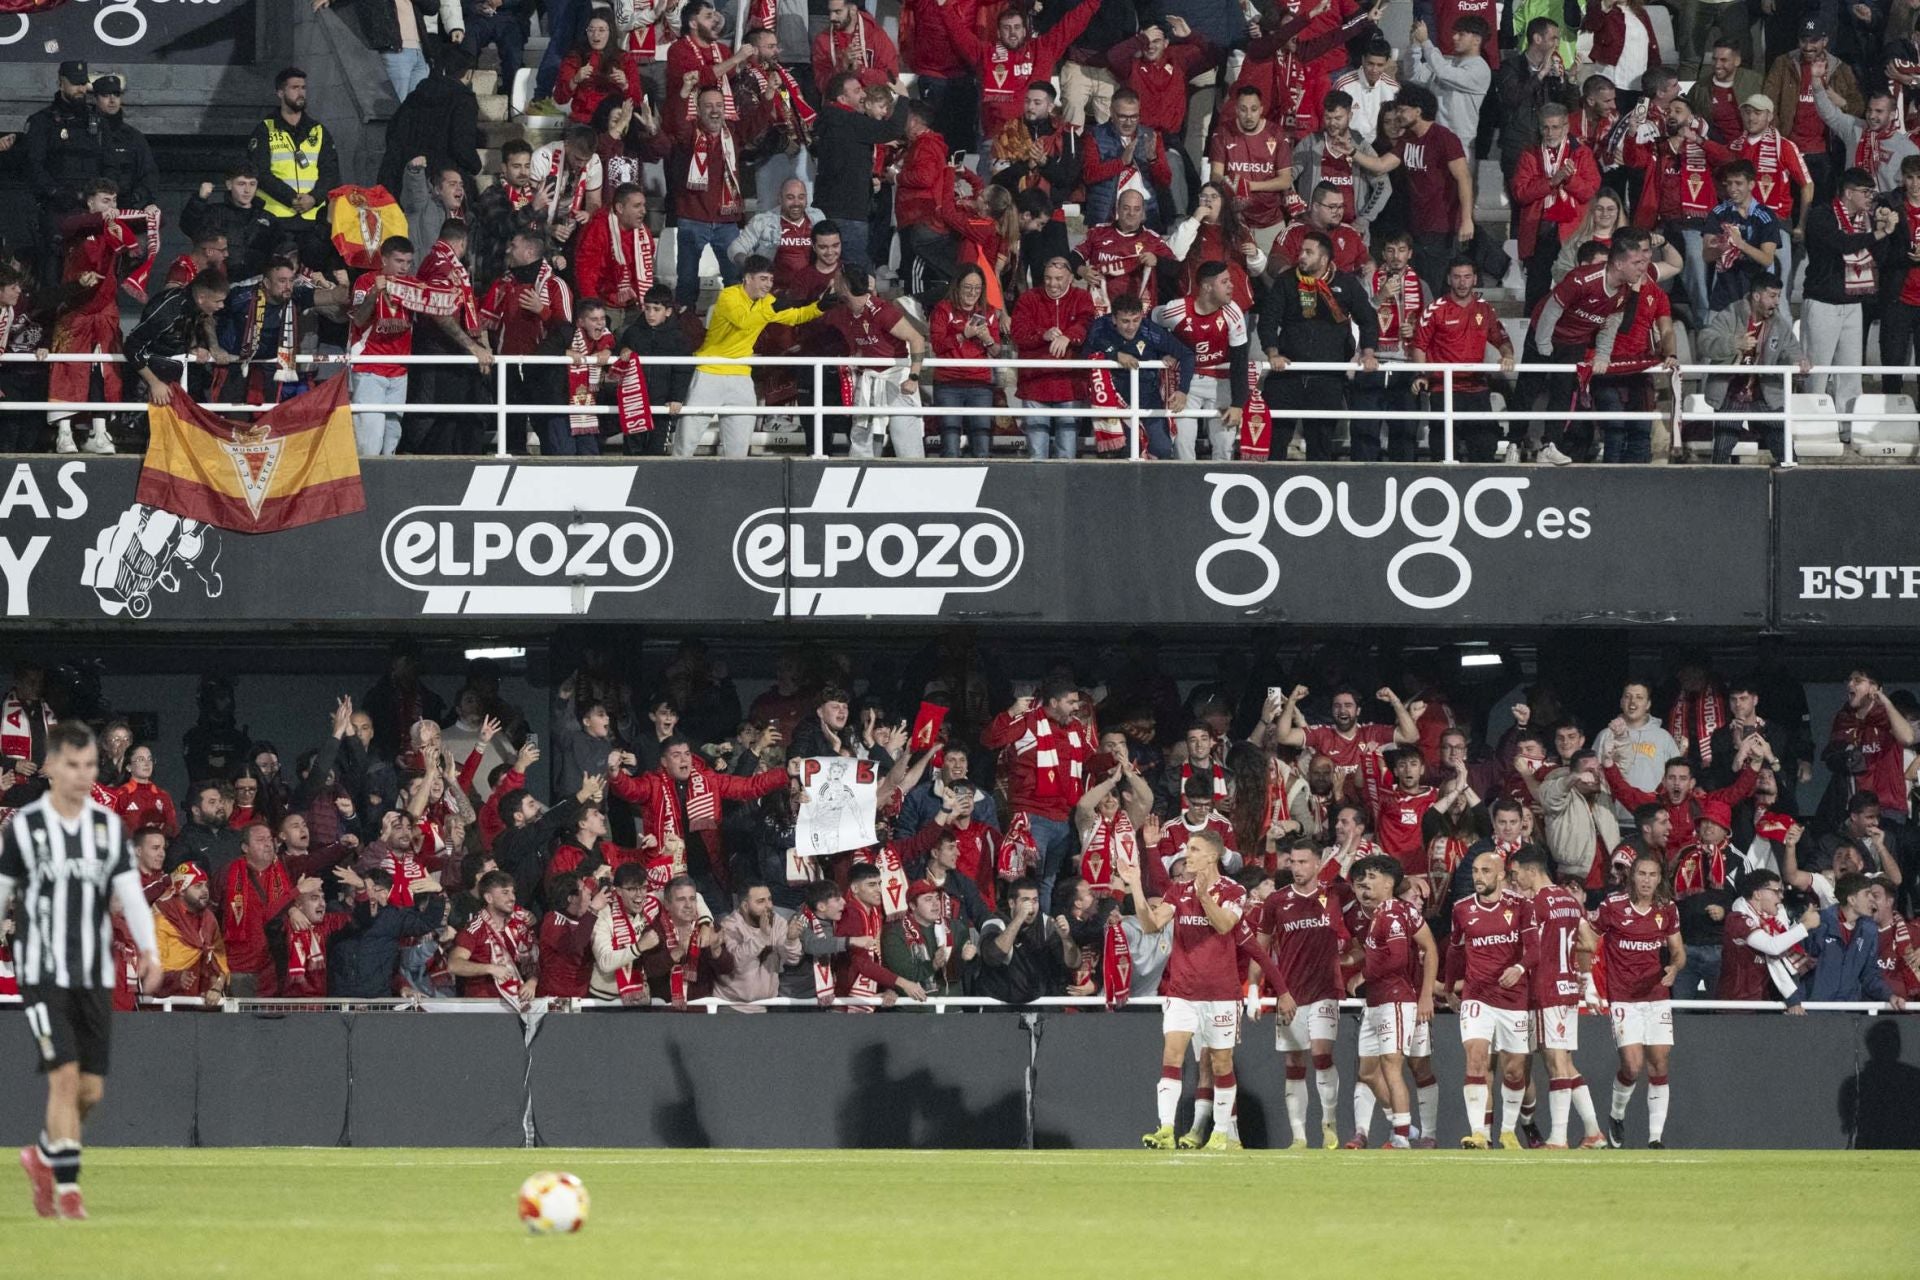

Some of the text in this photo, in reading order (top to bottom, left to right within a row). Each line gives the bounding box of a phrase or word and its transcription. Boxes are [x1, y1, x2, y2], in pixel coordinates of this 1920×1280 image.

[780, 237, 812, 246] NVERS
[1195, 472, 1592, 609] gougo.es
[805, 760, 821, 787] P
[1179, 915, 1212, 926] INVERS
